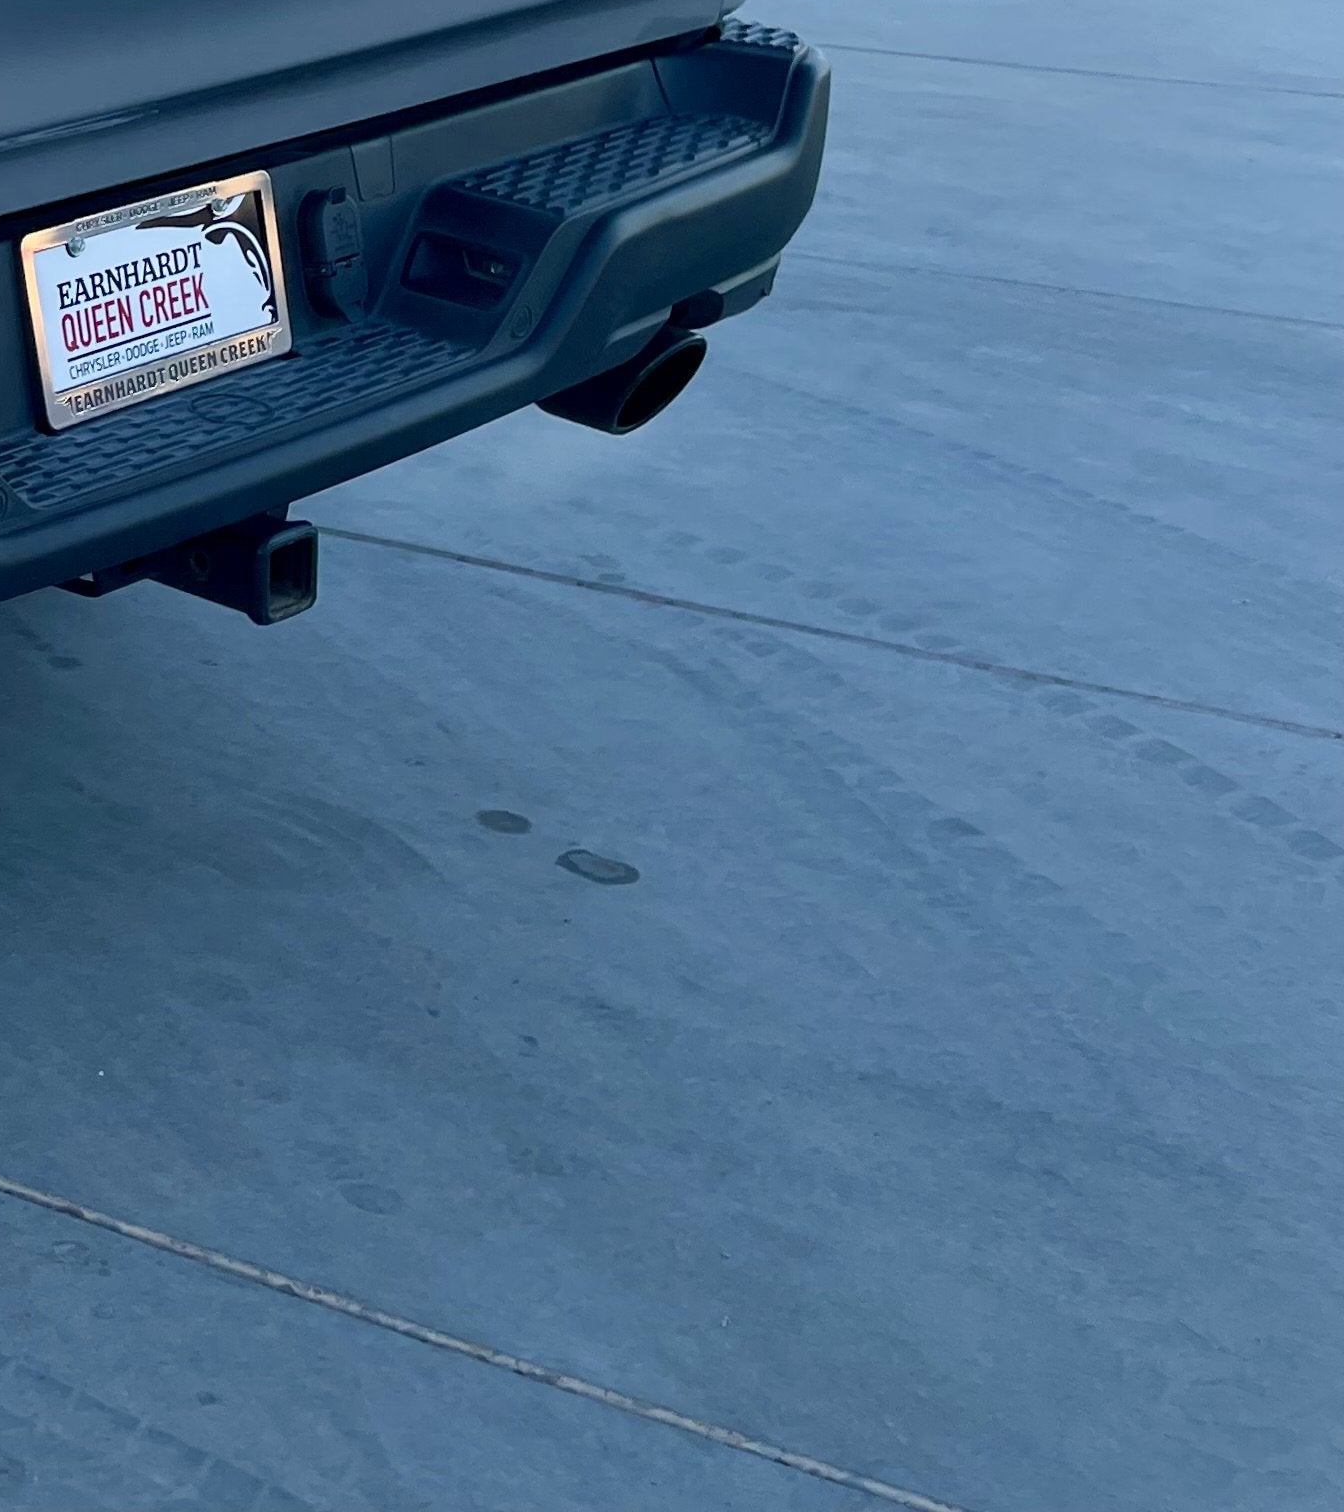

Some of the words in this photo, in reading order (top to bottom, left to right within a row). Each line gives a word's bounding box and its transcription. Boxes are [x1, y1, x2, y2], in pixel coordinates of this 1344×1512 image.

[167, 193, 190, 210] JEEP
[195, 185, 218, 201] RAM
[56, 241, 203, 310] EARNHARDT
[61, 294, 134, 353] QUEEN
[139, 272, 210, 329] CREEK
[69, 351, 122, 380] CHRYSLER
[125, 340, 161, 361] DODGE
[164, 330, 188, 350] JEEP
[192, 320, 215, 340] RAM
[75, 367, 167, 413] EARNHARDT
[169, 350, 218, 382] QUEEN
[220, 335, 268, 364] CREEK
